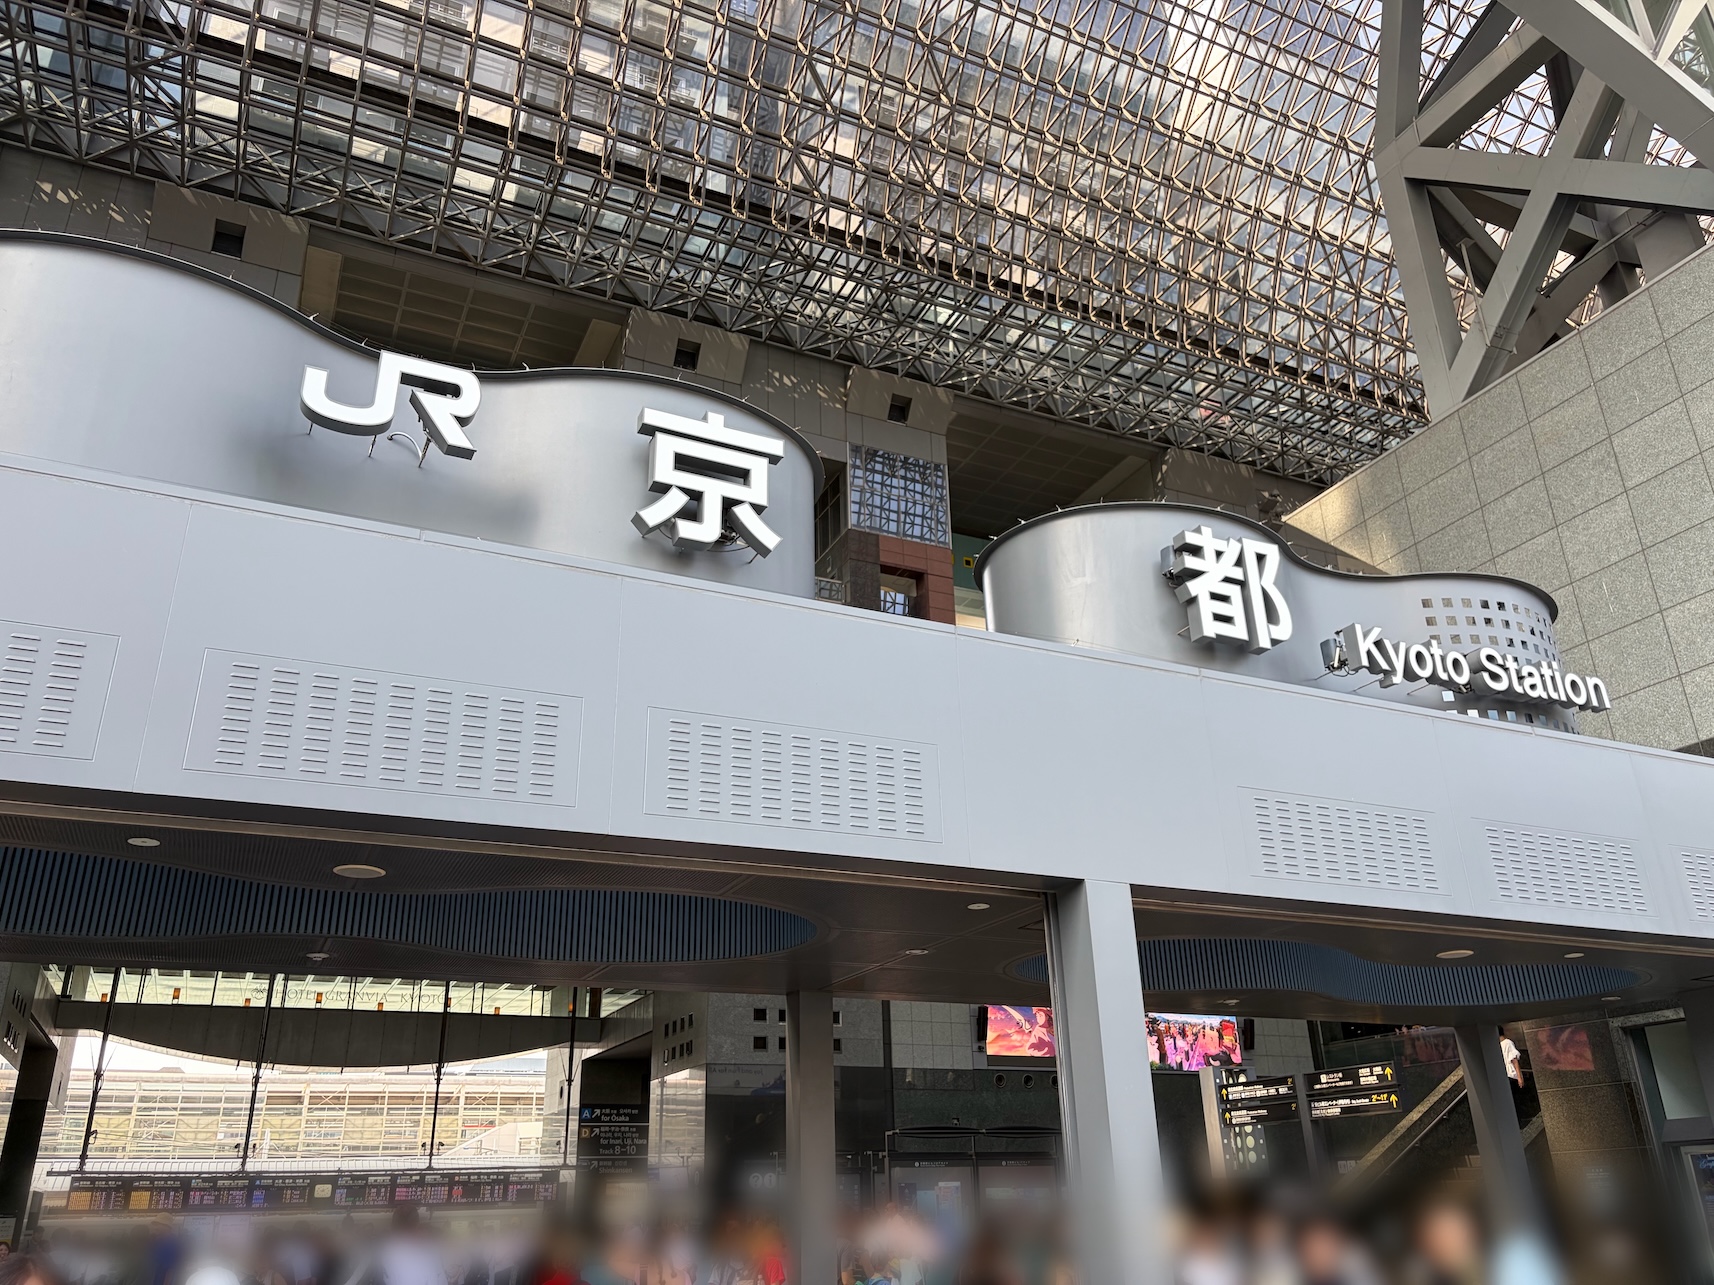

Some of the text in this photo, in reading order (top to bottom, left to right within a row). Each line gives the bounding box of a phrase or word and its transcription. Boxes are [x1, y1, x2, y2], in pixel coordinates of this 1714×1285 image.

[300, 350, 482, 458] JR
[634, 408, 785, 557] 京
[1174, 526, 1293, 652] 都
[1352, 622, 1611, 711] Kyoto Station
[275, 988, 316, 1000] HOTEL
[325, 989, 388, 1003] GRANVIA
[583, 1110, 590, 1118] A
[583, 1129, 589, 1137] D
